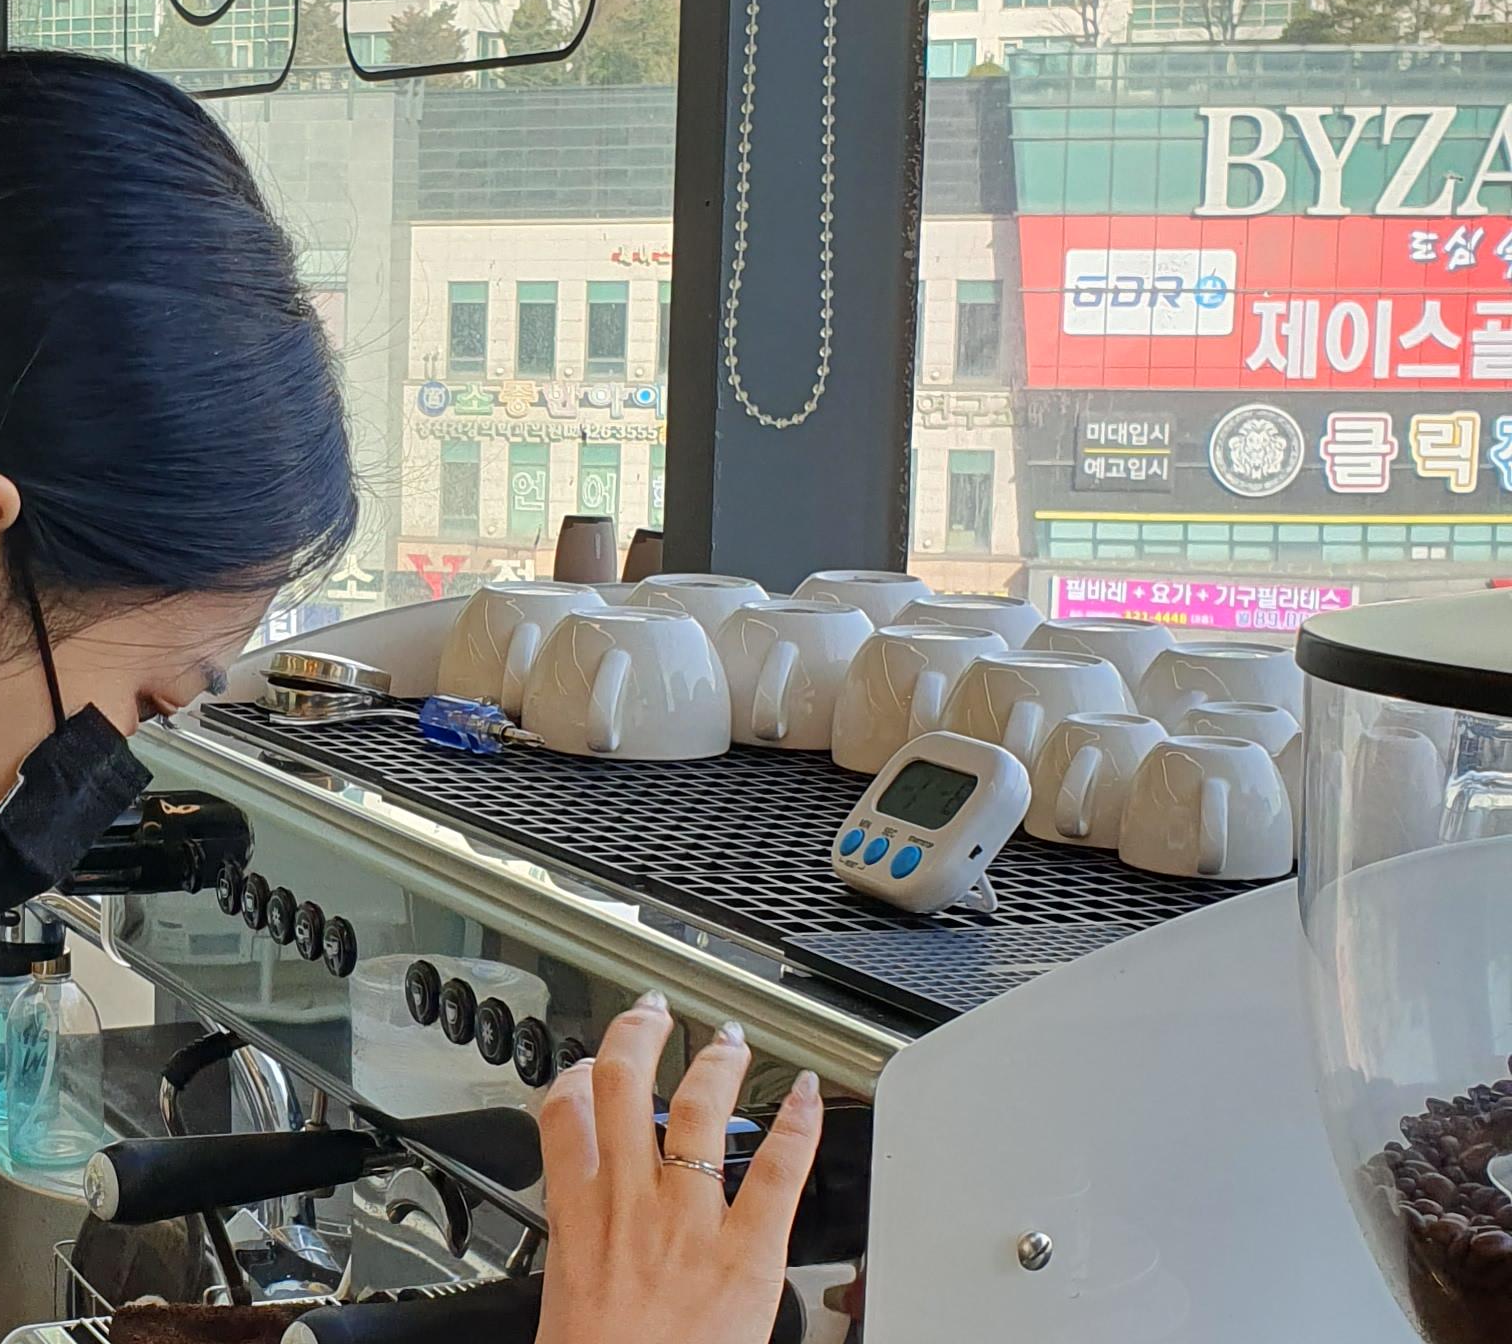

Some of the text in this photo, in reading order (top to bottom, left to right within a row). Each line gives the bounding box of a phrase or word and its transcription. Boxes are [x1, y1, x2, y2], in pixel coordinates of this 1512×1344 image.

[1086, 421, 1171, 445] 미대입시
[1083, 457, 1169, 481] 예고입시
[1064, 576, 1128, 603] 필바레
[1150, 581, 1192, 605] 요가
[1215, 583, 1341, 612] 기구필라테스
